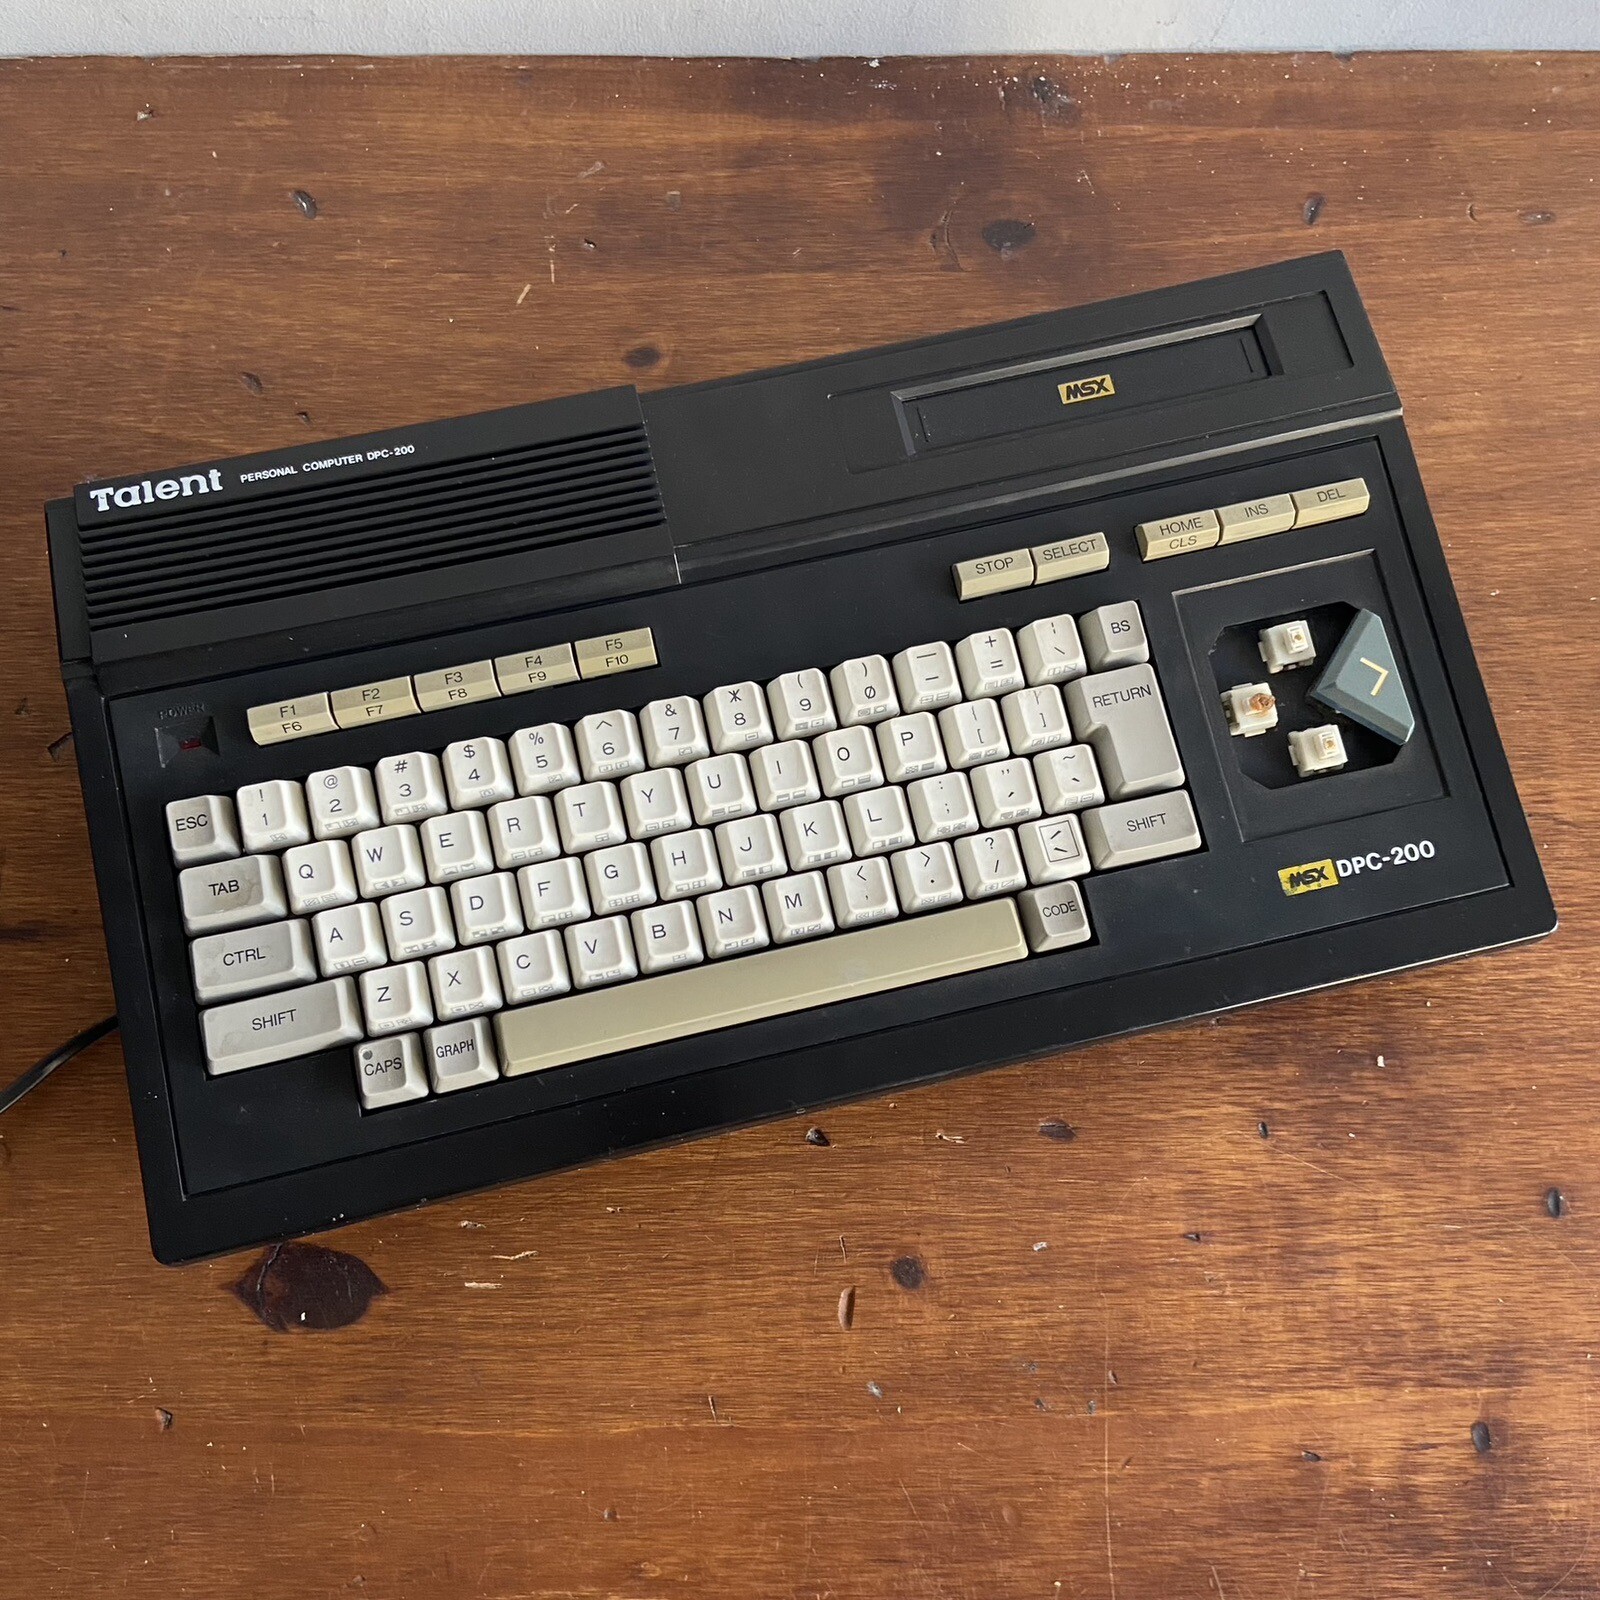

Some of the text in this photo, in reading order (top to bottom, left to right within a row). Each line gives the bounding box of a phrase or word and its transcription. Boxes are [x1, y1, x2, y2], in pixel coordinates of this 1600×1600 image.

[1066, 377, 1110, 401] MSX
[240, 444, 415, 484] PERSONAL COMPUTER DPC-200
[89, 468, 224, 512] Talent
[1316, 488, 1346, 502] DEL
[1244, 504, 1268, 517] INS
[1160, 517, 1203, 537] HOME
[1169, 532, 1197, 553] CLS
[1043, 539, 1096, 561] SELECT
[976, 557, 1013, 574] STOP
[1111, 620, 1130, 634] BS
[606, 638, 623, 650] F5
[985, 636, 996, 647] +
[525, 655, 542, 668] F4
[606, 655, 628, 667] F10
[991, 660, 1003, 668] =
[445, 672, 463, 684] F3
[528, 671, 546, 683] F9
[362, 688, 380, 701] F2
[448, 688, 467, 700] F8
[1093, 684, 1151, 707] RETURN
[280, 705, 298, 718] F1
[366, 705, 383, 716] F7
[665, 704, 677, 716] &
[800, 699, 811, 711] 9
[734, 713, 746, 725] 8
[282, 722, 302, 733] F6
[669, 727, 679, 740] 7
[529, 732, 544, 745] %
[901, 732, 913, 746] P
[464, 745, 475, 758] $
[603, 742, 614, 755] 6
[837, 747, 850, 761] O
[395, 760, 407, 773] #
[536, 755, 548, 768] 5
[469, 769, 480, 780] 4
[707, 774, 721, 789] U
[323, 775, 338, 789] @
[259, 789, 263, 802] !
[400, 784, 411, 797] 3
[641, 788, 653, 803] Y
[330, 799, 342, 812] 2
[573, 802, 585, 817] T
[176, 814, 208, 831] ESC
[263, 814, 267, 825] 1
[867, 809, 882, 822] L
[1127, 813, 1165, 832] SHIFT
[507, 817, 521, 832] R
[803, 822, 817, 836] K
[439, 833, 454, 848] E
[740, 837, 752, 851] J
[985, 837, 994, 850] ?
[366, 847, 382, 862] W
[672, 851, 686, 865] H
[921, 852, 930, 867] >
[995, 860, 999, 872] /
[1288, 840, 1435, 888] MSX DPC-200
[299, 864, 314, 879] Q
[604, 865, 618, 879] G
[857, 866, 866, 881] <
[208, 880, 239, 896] TAB
[538, 881, 550, 897] F
[470, 896, 483, 910] D
[785, 893, 802, 909] M
[718, 908, 733, 923] N
[1043, 901, 1077, 917] CODE
[400, 911, 413, 926] S
[330, 928, 343, 943] A
[652, 924, 666, 939] B
[584, 939, 597, 954] V
[223, 948, 265, 966] CTRL
[517, 955, 530, 969] C
[447, 971, 461, 986] X
[377, 986, 391, 1002] Z
[252, 1009, 296, 1030] SHIFT
[436, 1039, 474, 1058] GRAPH
[363, 1055, 402, 1076] CAPS
